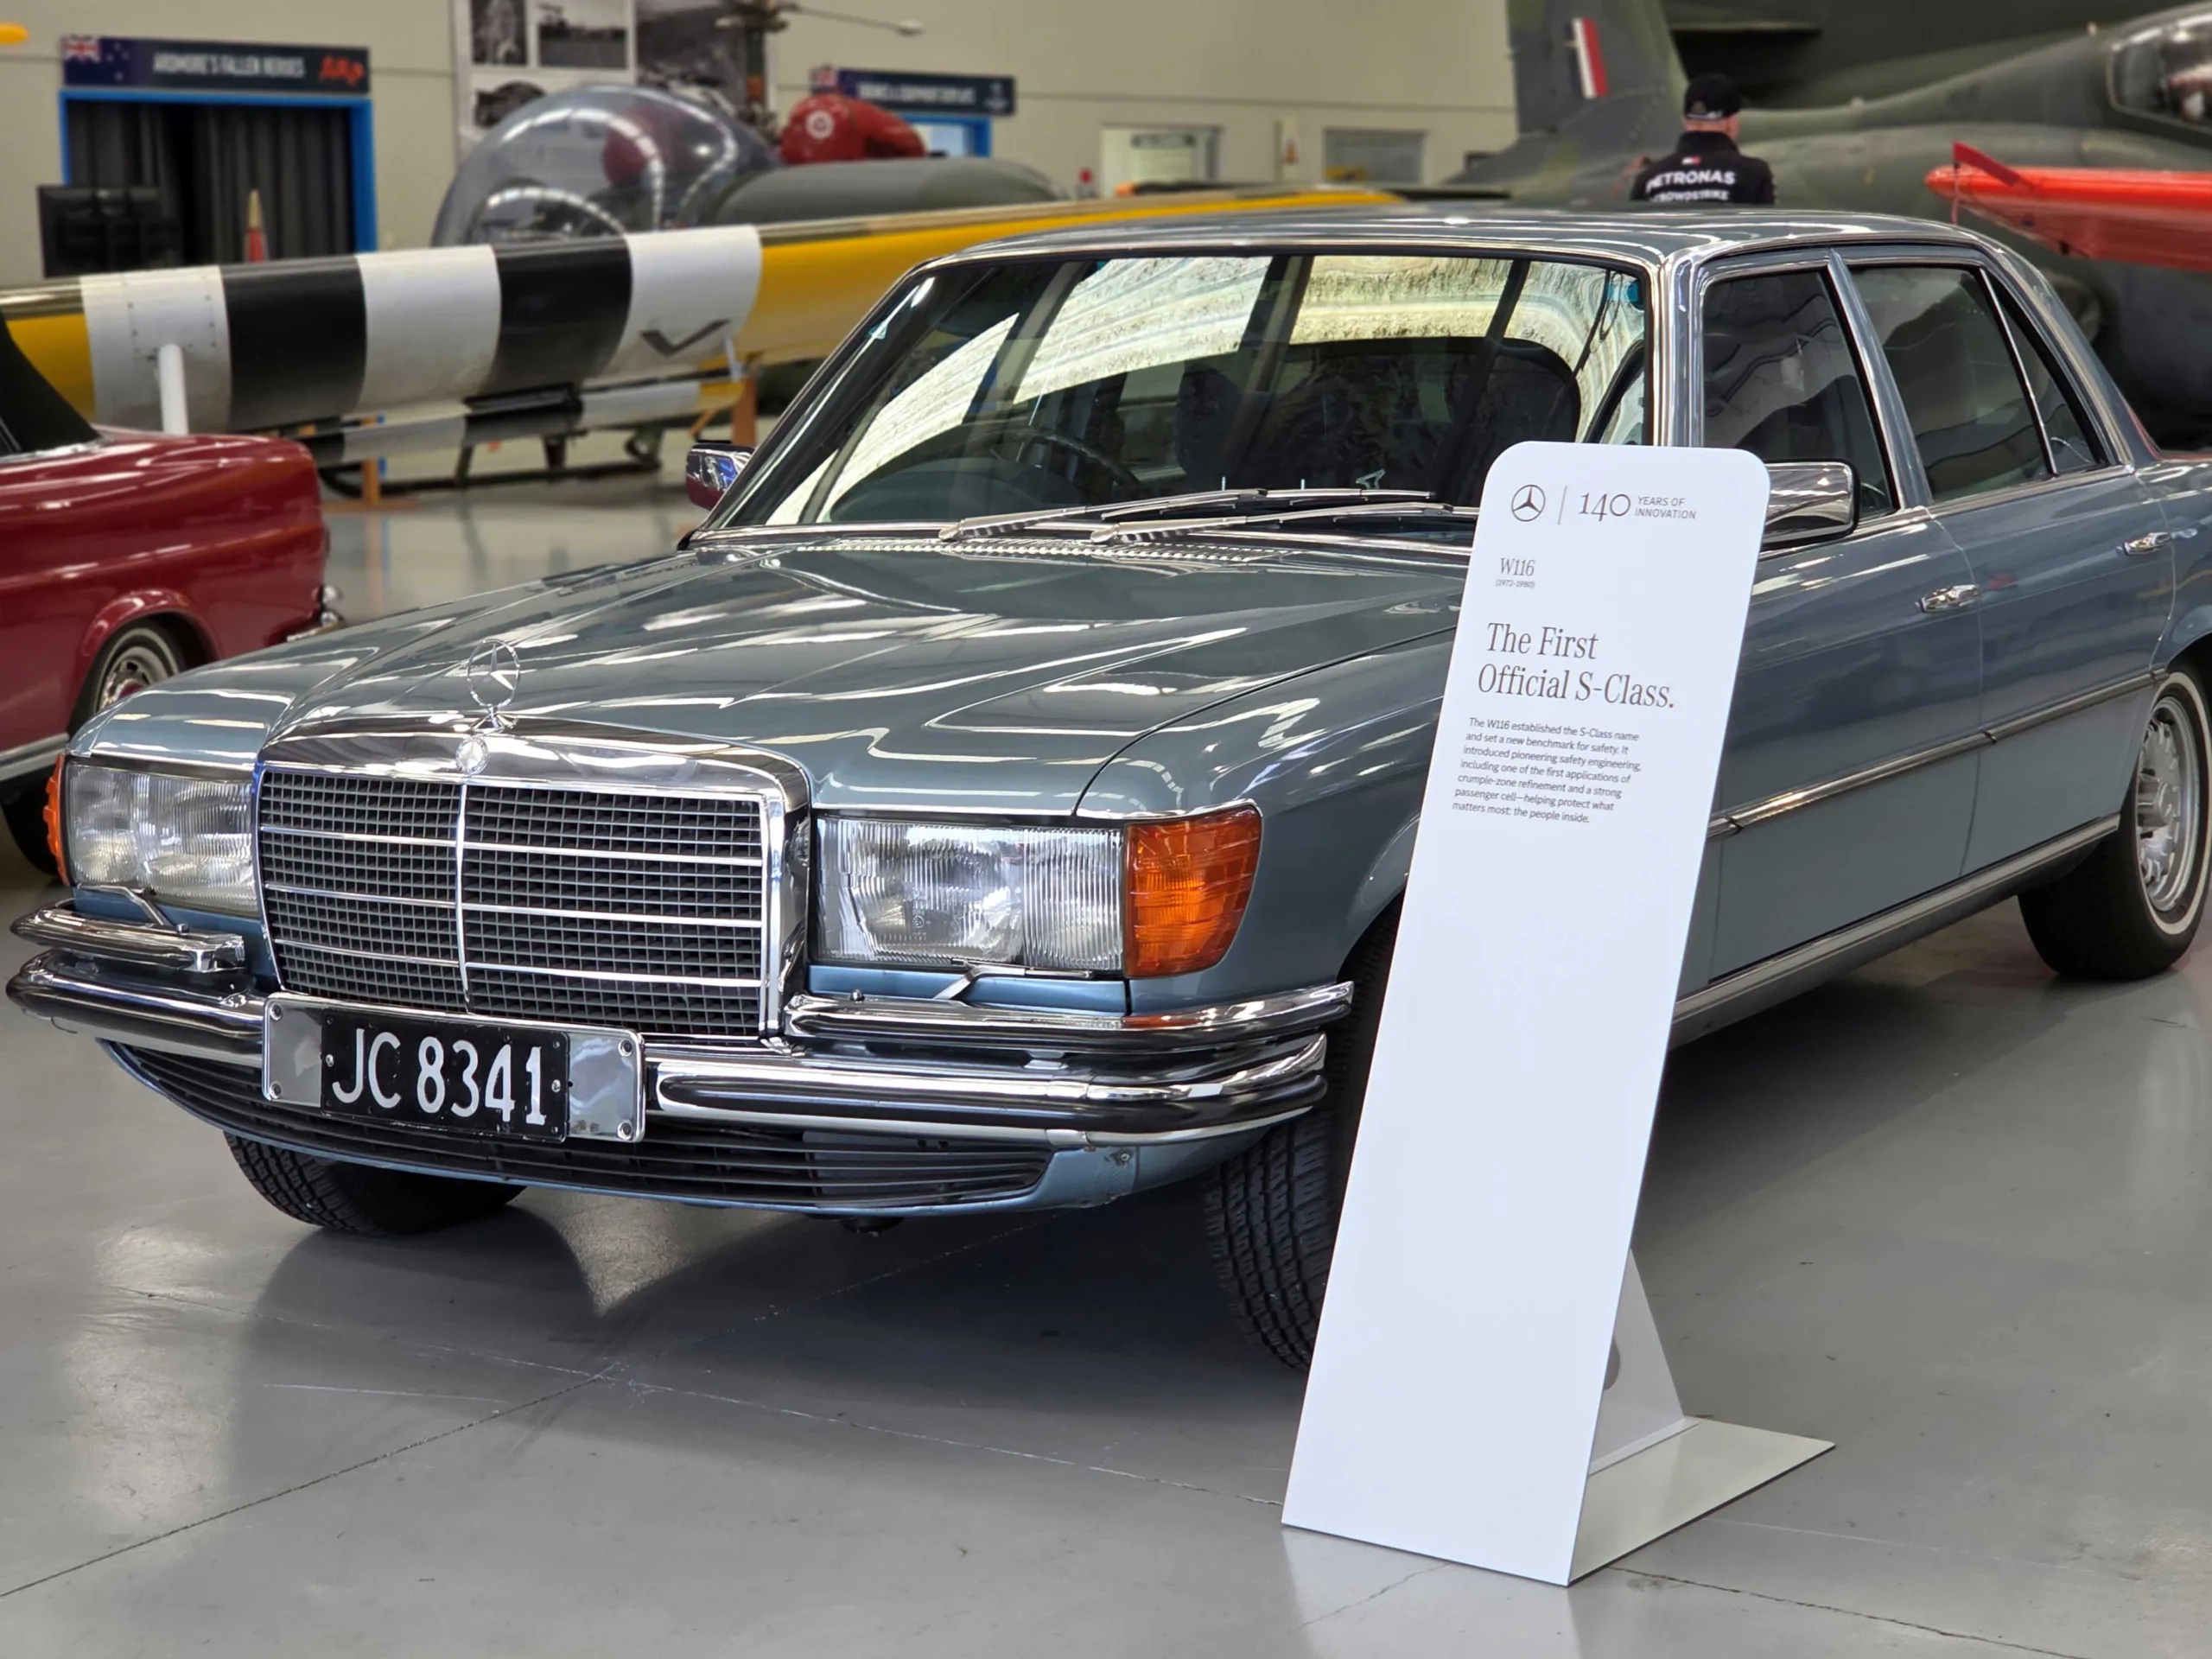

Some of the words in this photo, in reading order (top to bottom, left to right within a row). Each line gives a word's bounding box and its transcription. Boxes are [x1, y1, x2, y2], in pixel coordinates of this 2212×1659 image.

[1578, 493, 1630, 522] 140
[1637, 496, 1669, 506] YEARS
[1671, 498, 1685, 506] OF
[1635, 509, 1696, 519] INNOVATION
[1500, 557, 1535, 576] W116
[1486, 622, 1531, 654] The
[1537, 626, 1599, 659] First
[1478, 663, 1570, 699] Official
[1574, 671, 1675, 709] S-Class.
[1469, 717, 1484, 728] The
[1487, 721, 1510, 730] W116
[1511, 721, 1561, 734] established
[1563, 727, 1578, 736] the
[1580, 728, 1612, 739] S-Class
[1614, 733, 1640, 741] name
[1465, 733, 1482, 741] and
[1526, 738, 1574, 750] benchmark
[1577, 741, 1589, 751] for
[1622, 745, 1629, 754] It
[1463, 746, 1510, 759] introduced
[1511, 751, 1558, 765] pioneering
[1559, 755, 1586, 766] safety
[1460, 760, 1499, 772] including
[1519, 765, 1529, 773] of
[1530, 766, 1544, 775] the
[1547, 767, 1564, 778] first
[1566, 770, 1618, 783] applications
[1620, 774, 1631, 783] of
[1458, 774, 1516, 787] crumple-zone
[1518, 780, 1566, 792] refinement
[1567, 784, 1585, 793] and
[1593, 787, 1623, 799] strong
[1452, 801, 1485, 812] matters
[1514, 807, 1528, 817] the
[1529, 810, 1560, 821] people
[1454, 788, 1499, 800] passenger
[1558, 798, 1590, 809] protect
[1592, 802, 1614, 811] what
[332, 1027, 402, 1109] JC
[416, 1036, 547, 1126] 8341
